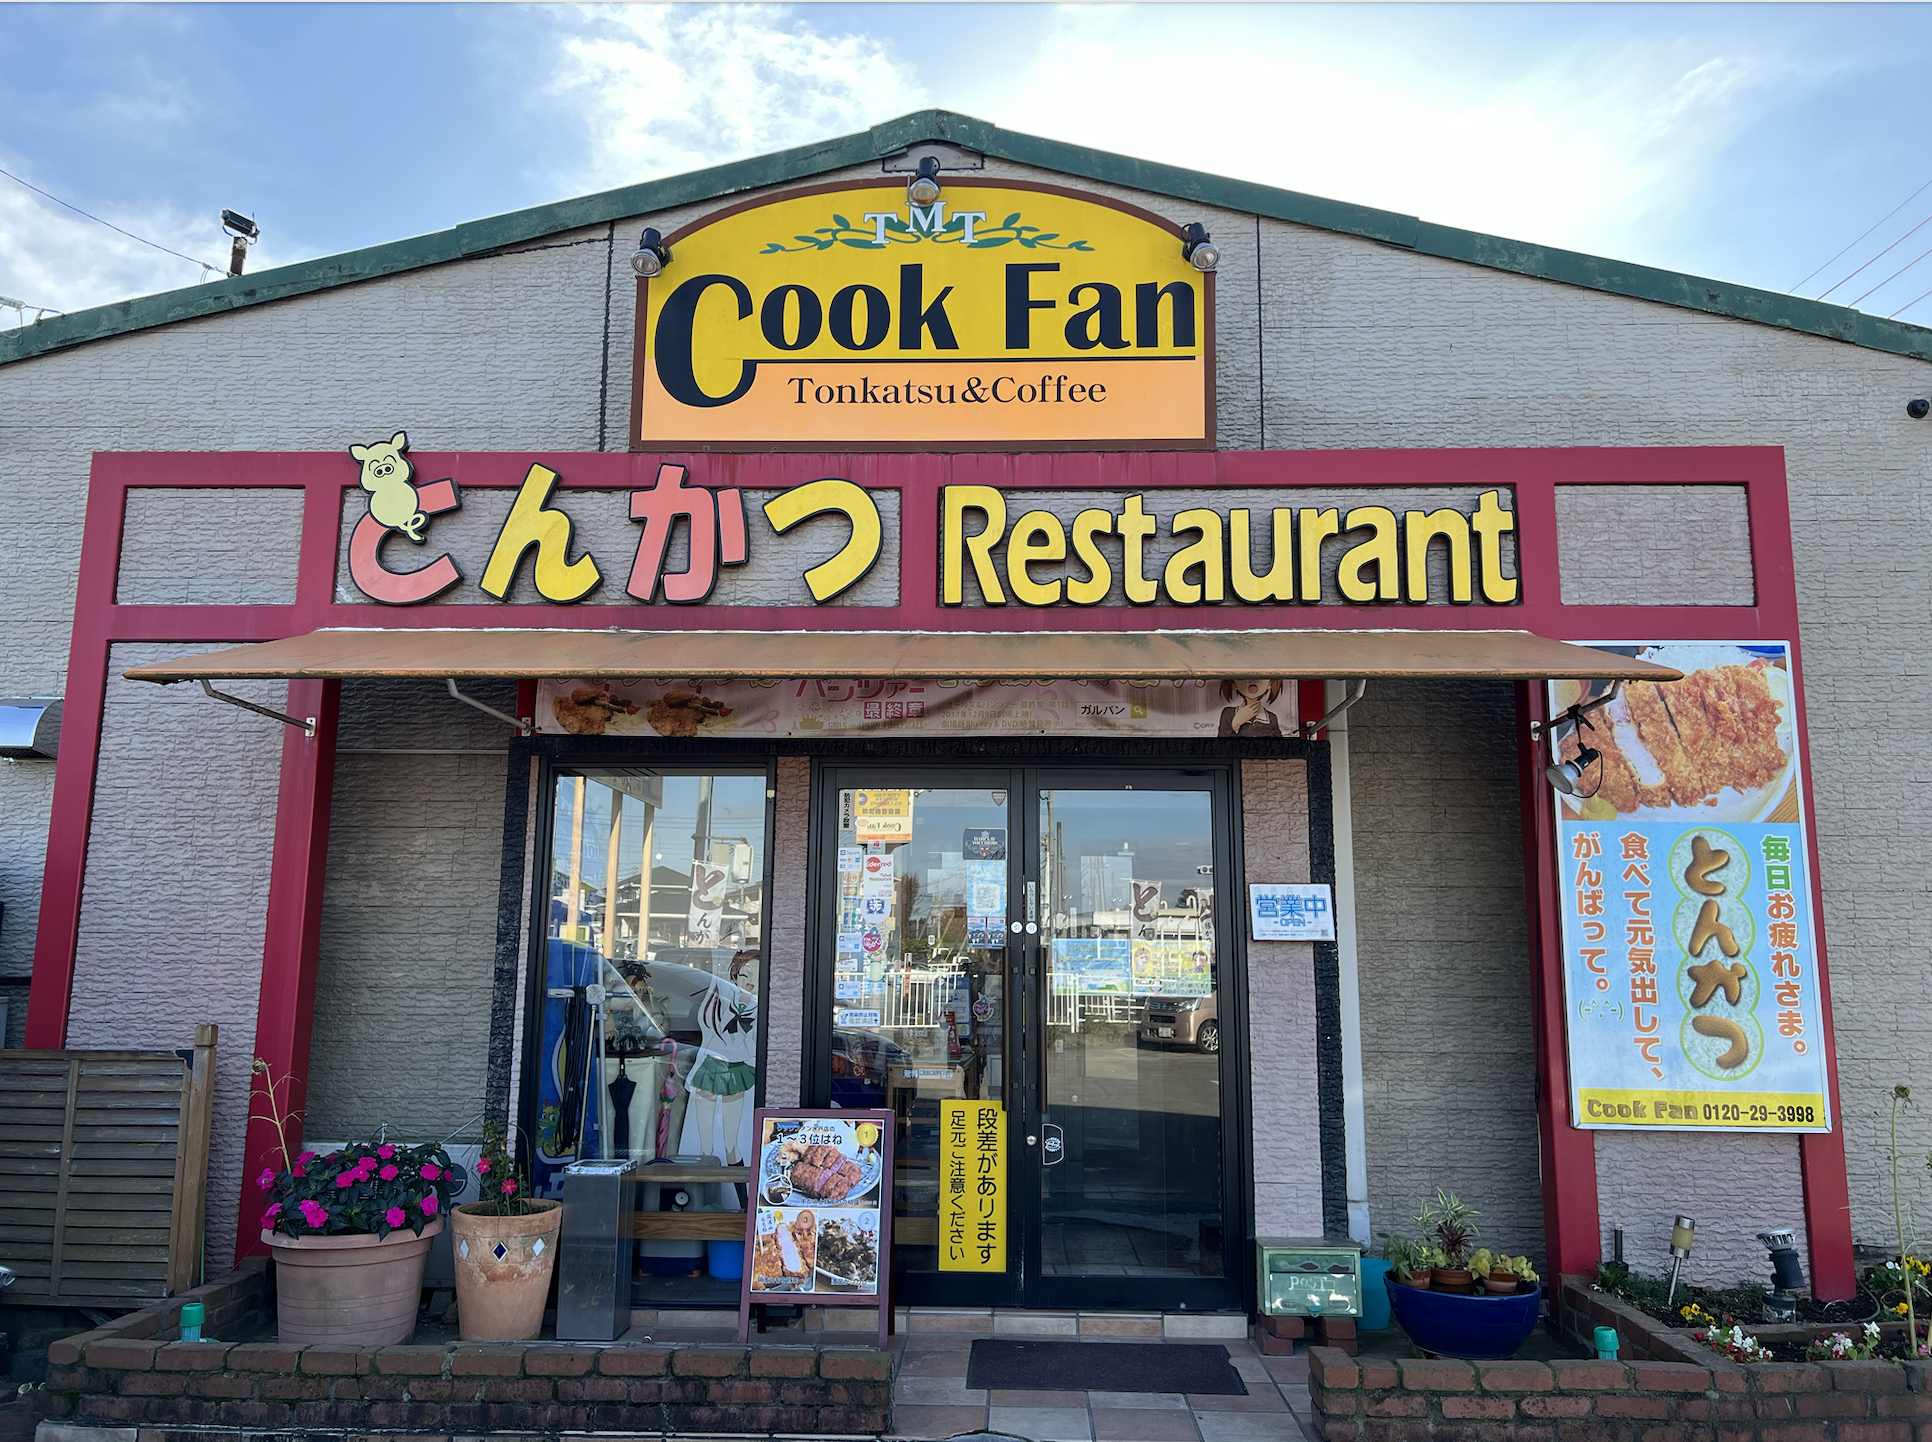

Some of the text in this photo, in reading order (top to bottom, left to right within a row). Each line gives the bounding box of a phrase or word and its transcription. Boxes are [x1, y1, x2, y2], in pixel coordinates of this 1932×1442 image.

[864, 201, 986, 244] TMT
[654, 262, 1196, 408] Cook Fan
[787, 375, 1107, 405] Tonkatsu&Coffee
[348, 463, 884, 606] とんかつ
[941, 485, 1520, 607] Restaurant
[864, 701, 925, 720] 最終章
[1080, 704, 1126, 716] ガルパン
[1255, 894, 1327, 918] 営業中
[1280, 918, 1306, 927] OPEN
[1572, 831, 1609, 994] がんばって。
[1619, 832, 1665, 1081] 食べて元気出して、
[1684, 836, 1749, 1070] とんかつ
[1760, 834, 1808, 1056] 毎日お疲れさま。
[1587, 1099, 1815, 1124] Cook Fan 0120-29-3998
[949, 1109, 966, 1262] 足元ご注意ください
[976, 1107, 998, 1265] 段差があります
